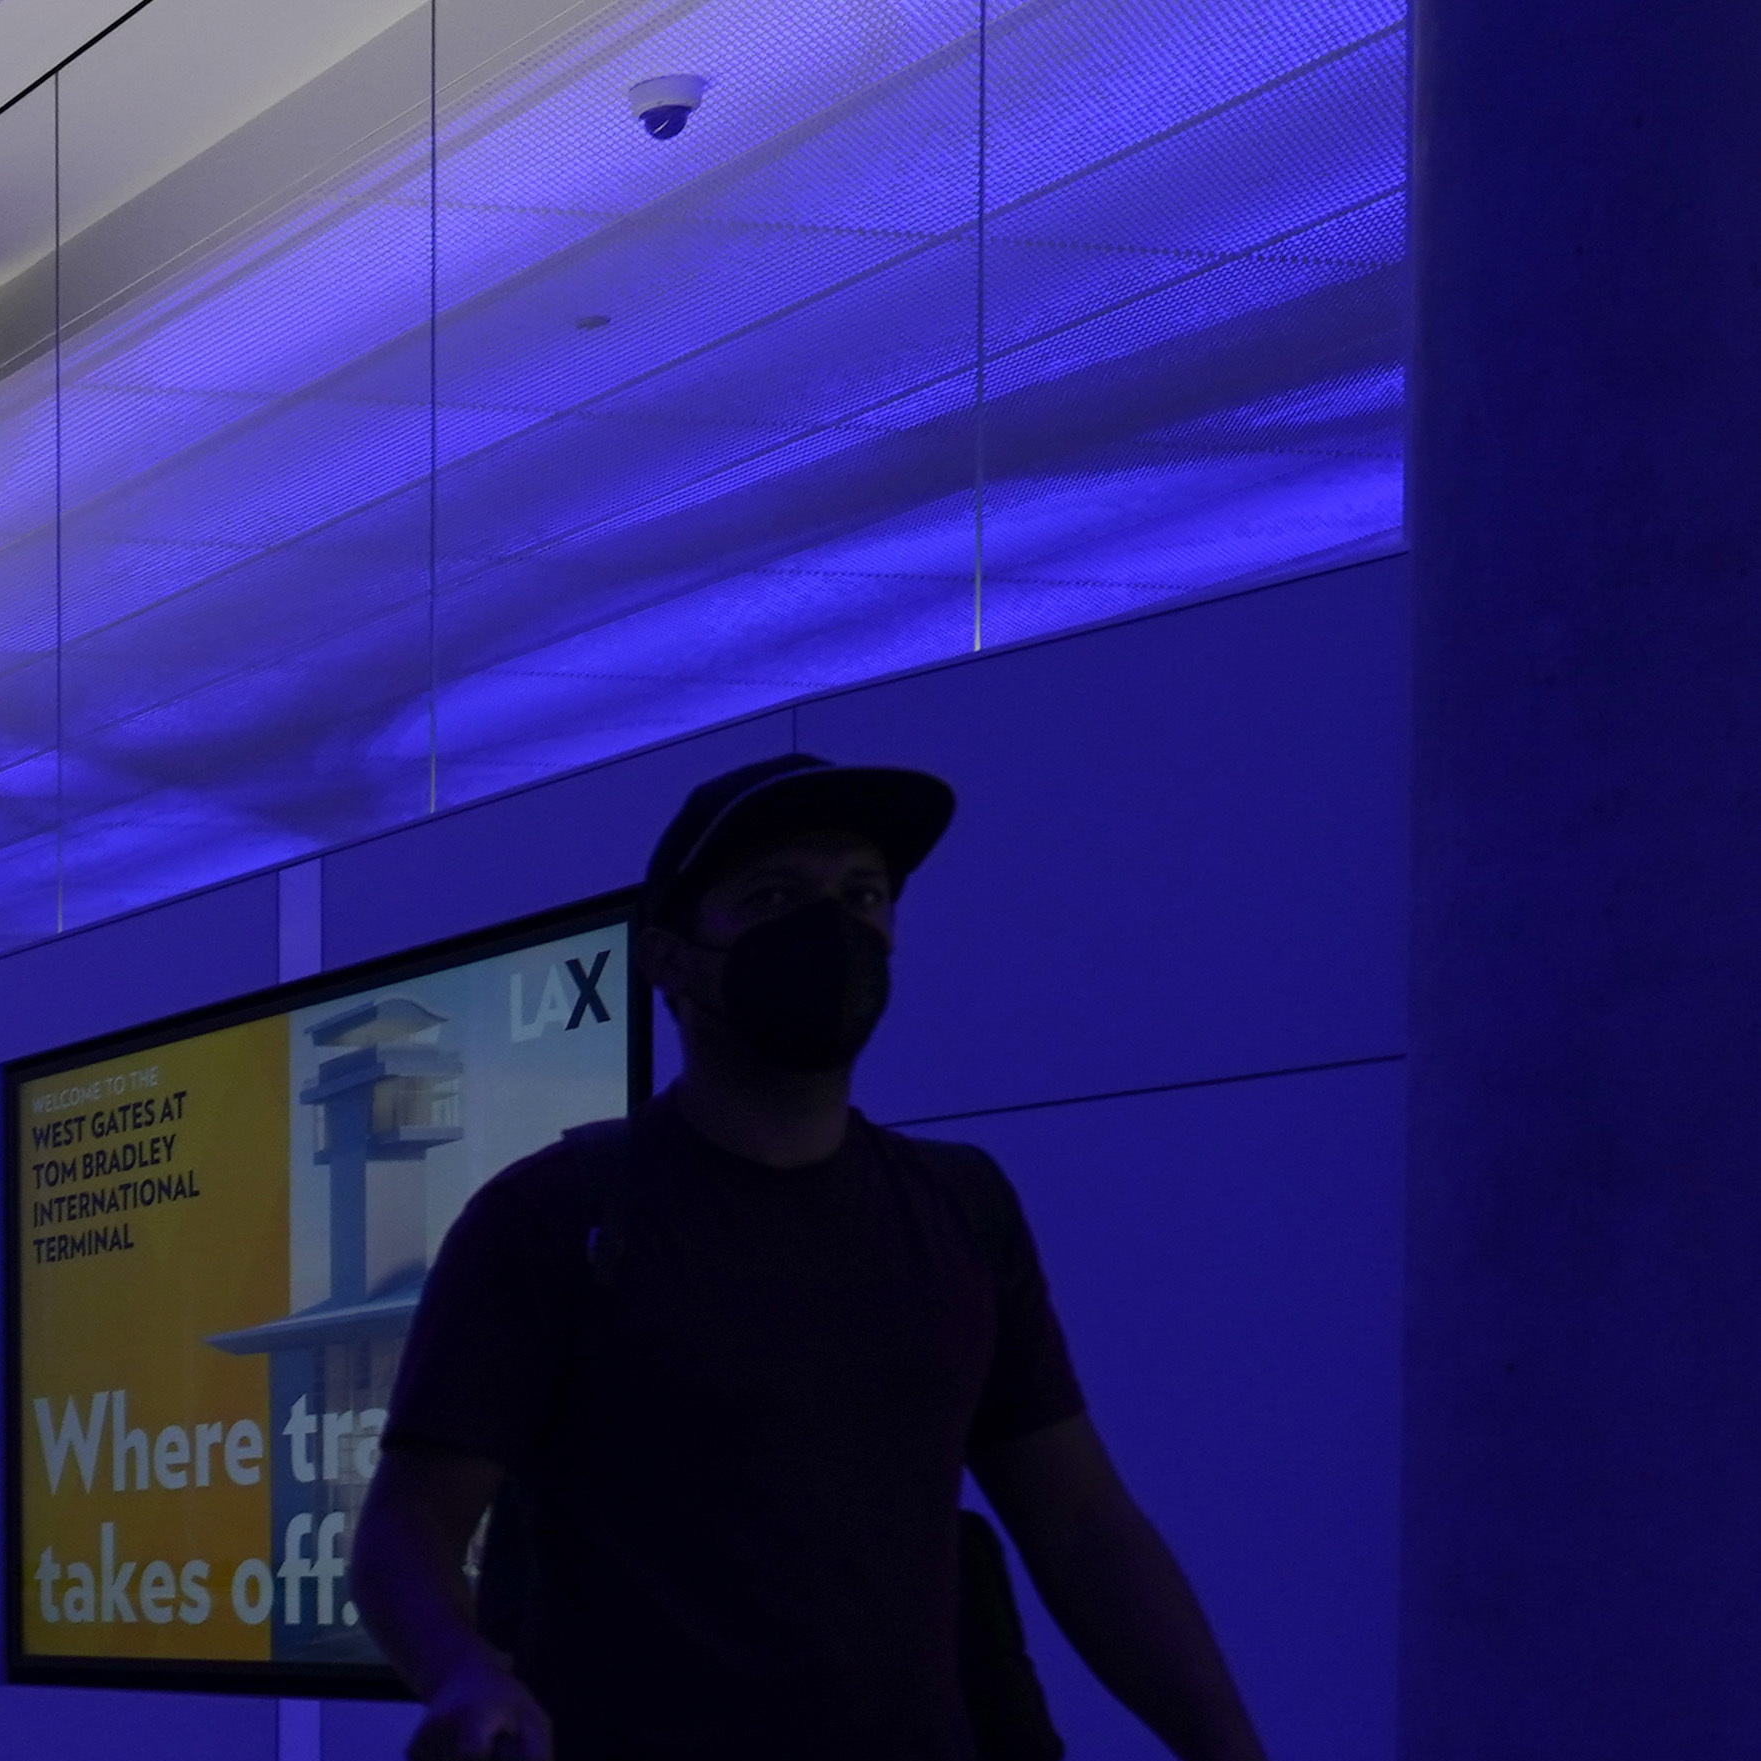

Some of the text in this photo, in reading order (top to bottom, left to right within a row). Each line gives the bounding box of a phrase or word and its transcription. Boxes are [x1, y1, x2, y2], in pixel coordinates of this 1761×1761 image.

[509, 949, 612, 1044] LAX
[33, 1066, 159, 1113] WELCOME TO THE
[32, 1091, 188, 1151] WEST GATES AT
[32, 1133, 177, 1190] TOM BRADLEY
[33, 1169, 200, 1228] INTERNATIONAL
[33, 1223, 134, 1264] TERMINAL
[33, 1389, 390, 1496] Where tra
[34, 1511, 360, 1627] takes off.
